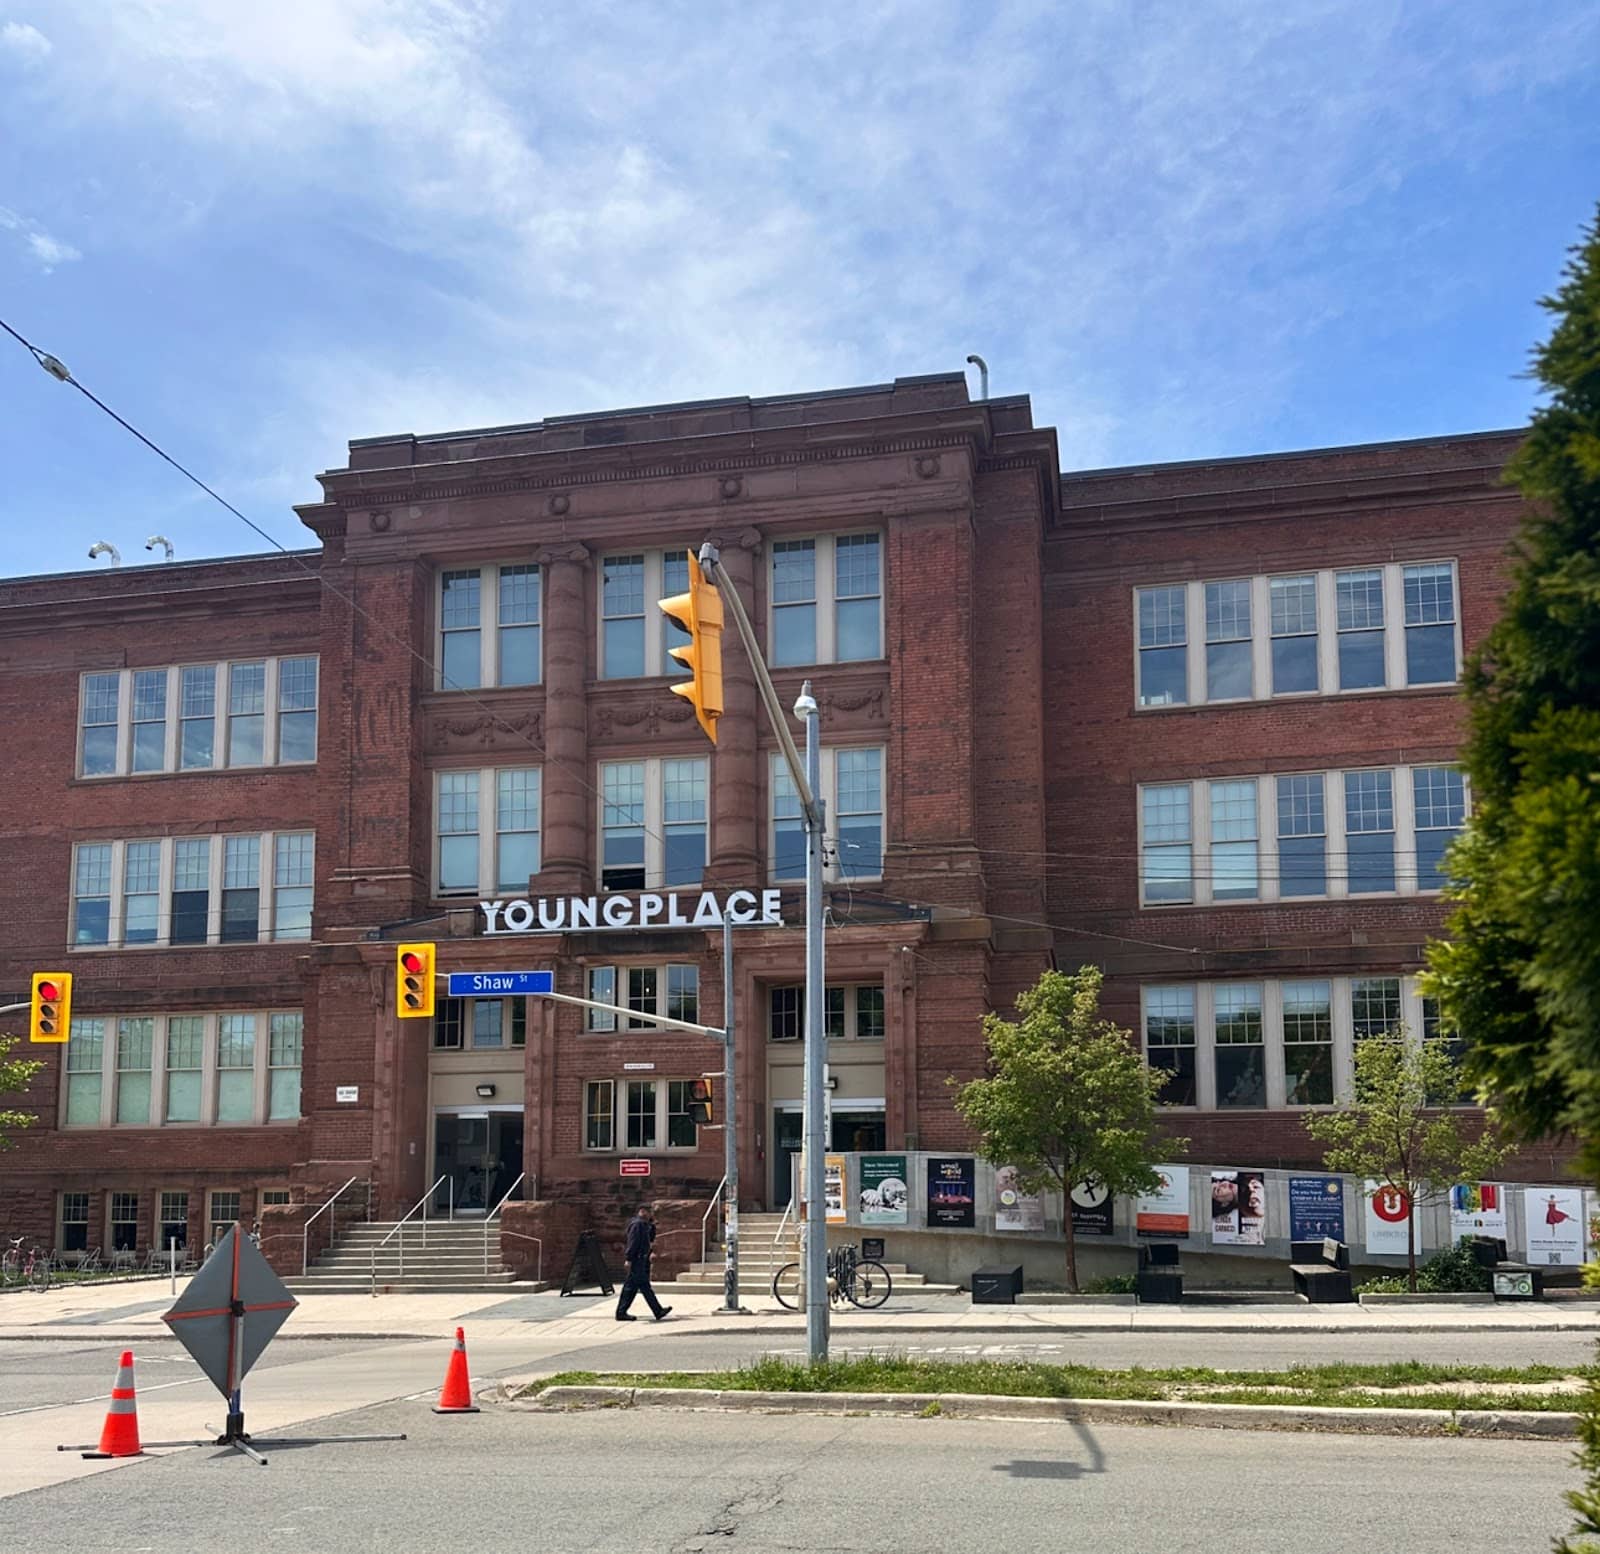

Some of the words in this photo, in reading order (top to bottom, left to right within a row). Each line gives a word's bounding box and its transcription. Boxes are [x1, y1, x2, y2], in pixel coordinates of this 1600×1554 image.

[480, 889, 781, 932] YOUNGPLACE
[473, 975, 514, 990] Shaw
[519, 974, 528, 983] St
